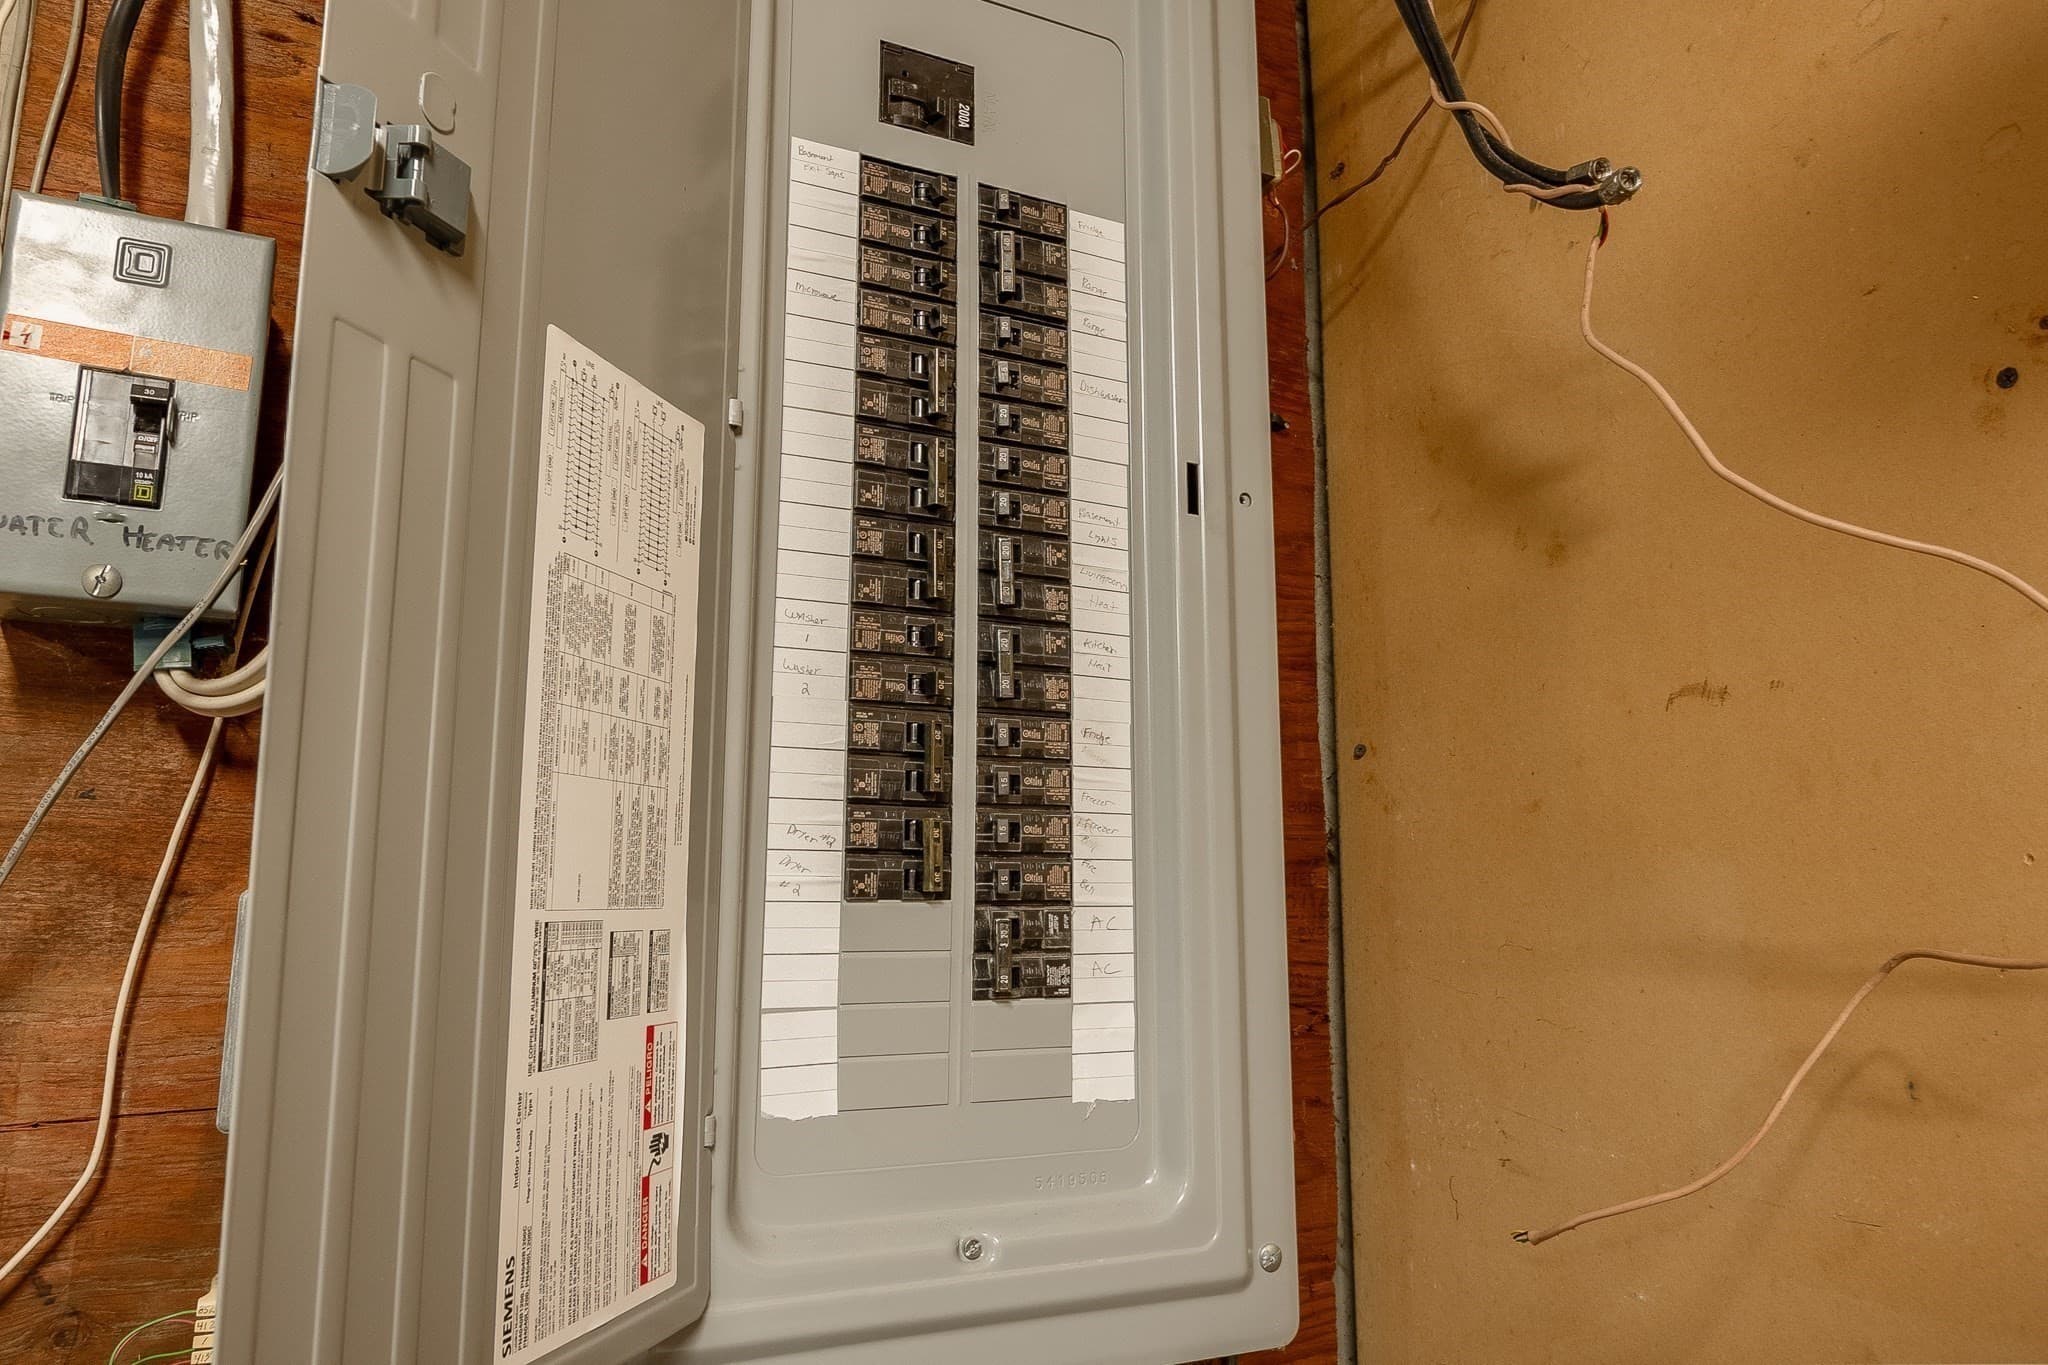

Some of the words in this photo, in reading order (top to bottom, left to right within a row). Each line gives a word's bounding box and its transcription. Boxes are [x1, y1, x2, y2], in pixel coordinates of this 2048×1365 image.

[958, 102, 970, 128] 200A
[144, 388, 156, 396] 30
[123, 524, 236, 560] HEATER
[801, 682, 810, 696] 2
[646, 1042, 654, 1095] PELIGRO
[641, 1196, 649, 1250] DANGER
[502, 1256, 515, 1358] SIEMENS
